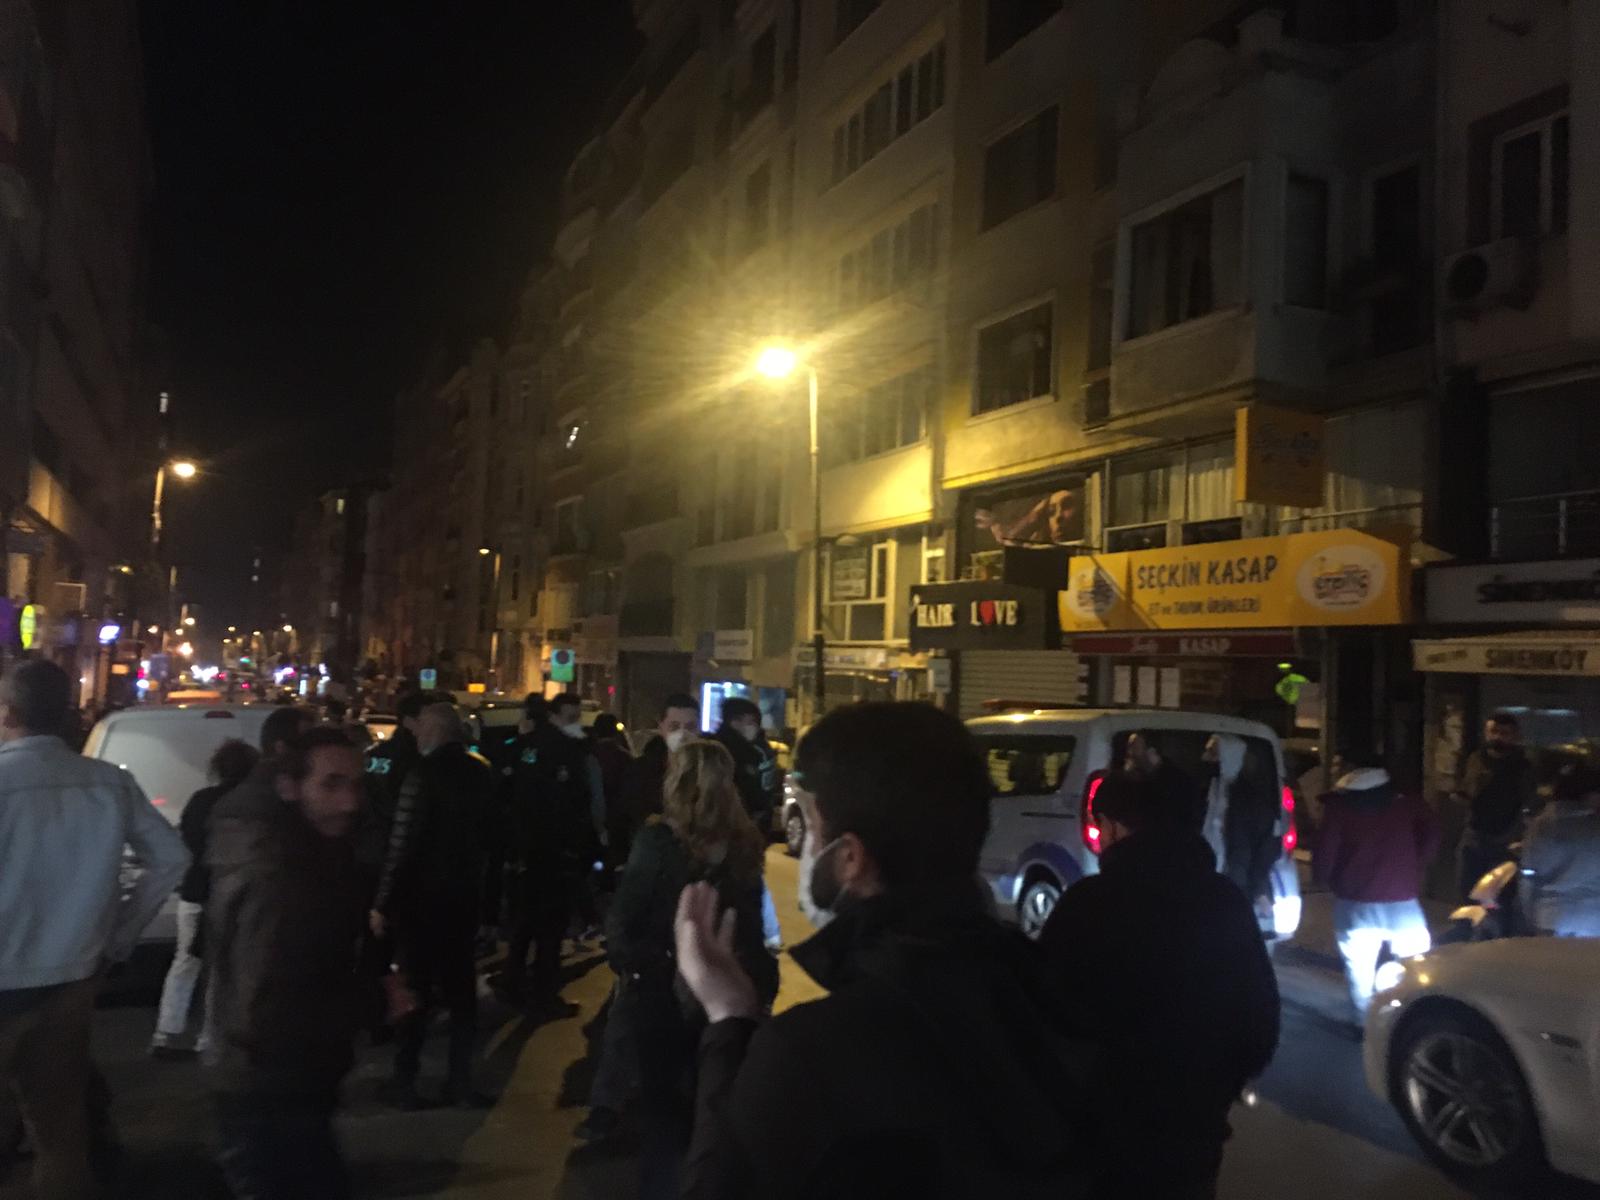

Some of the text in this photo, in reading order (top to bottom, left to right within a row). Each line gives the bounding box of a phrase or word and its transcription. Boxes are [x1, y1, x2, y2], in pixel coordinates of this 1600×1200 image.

[1137, 555, 1278, 593] SEÇKİN KASAP
[1179, 637, 1231, 656] KASAP
